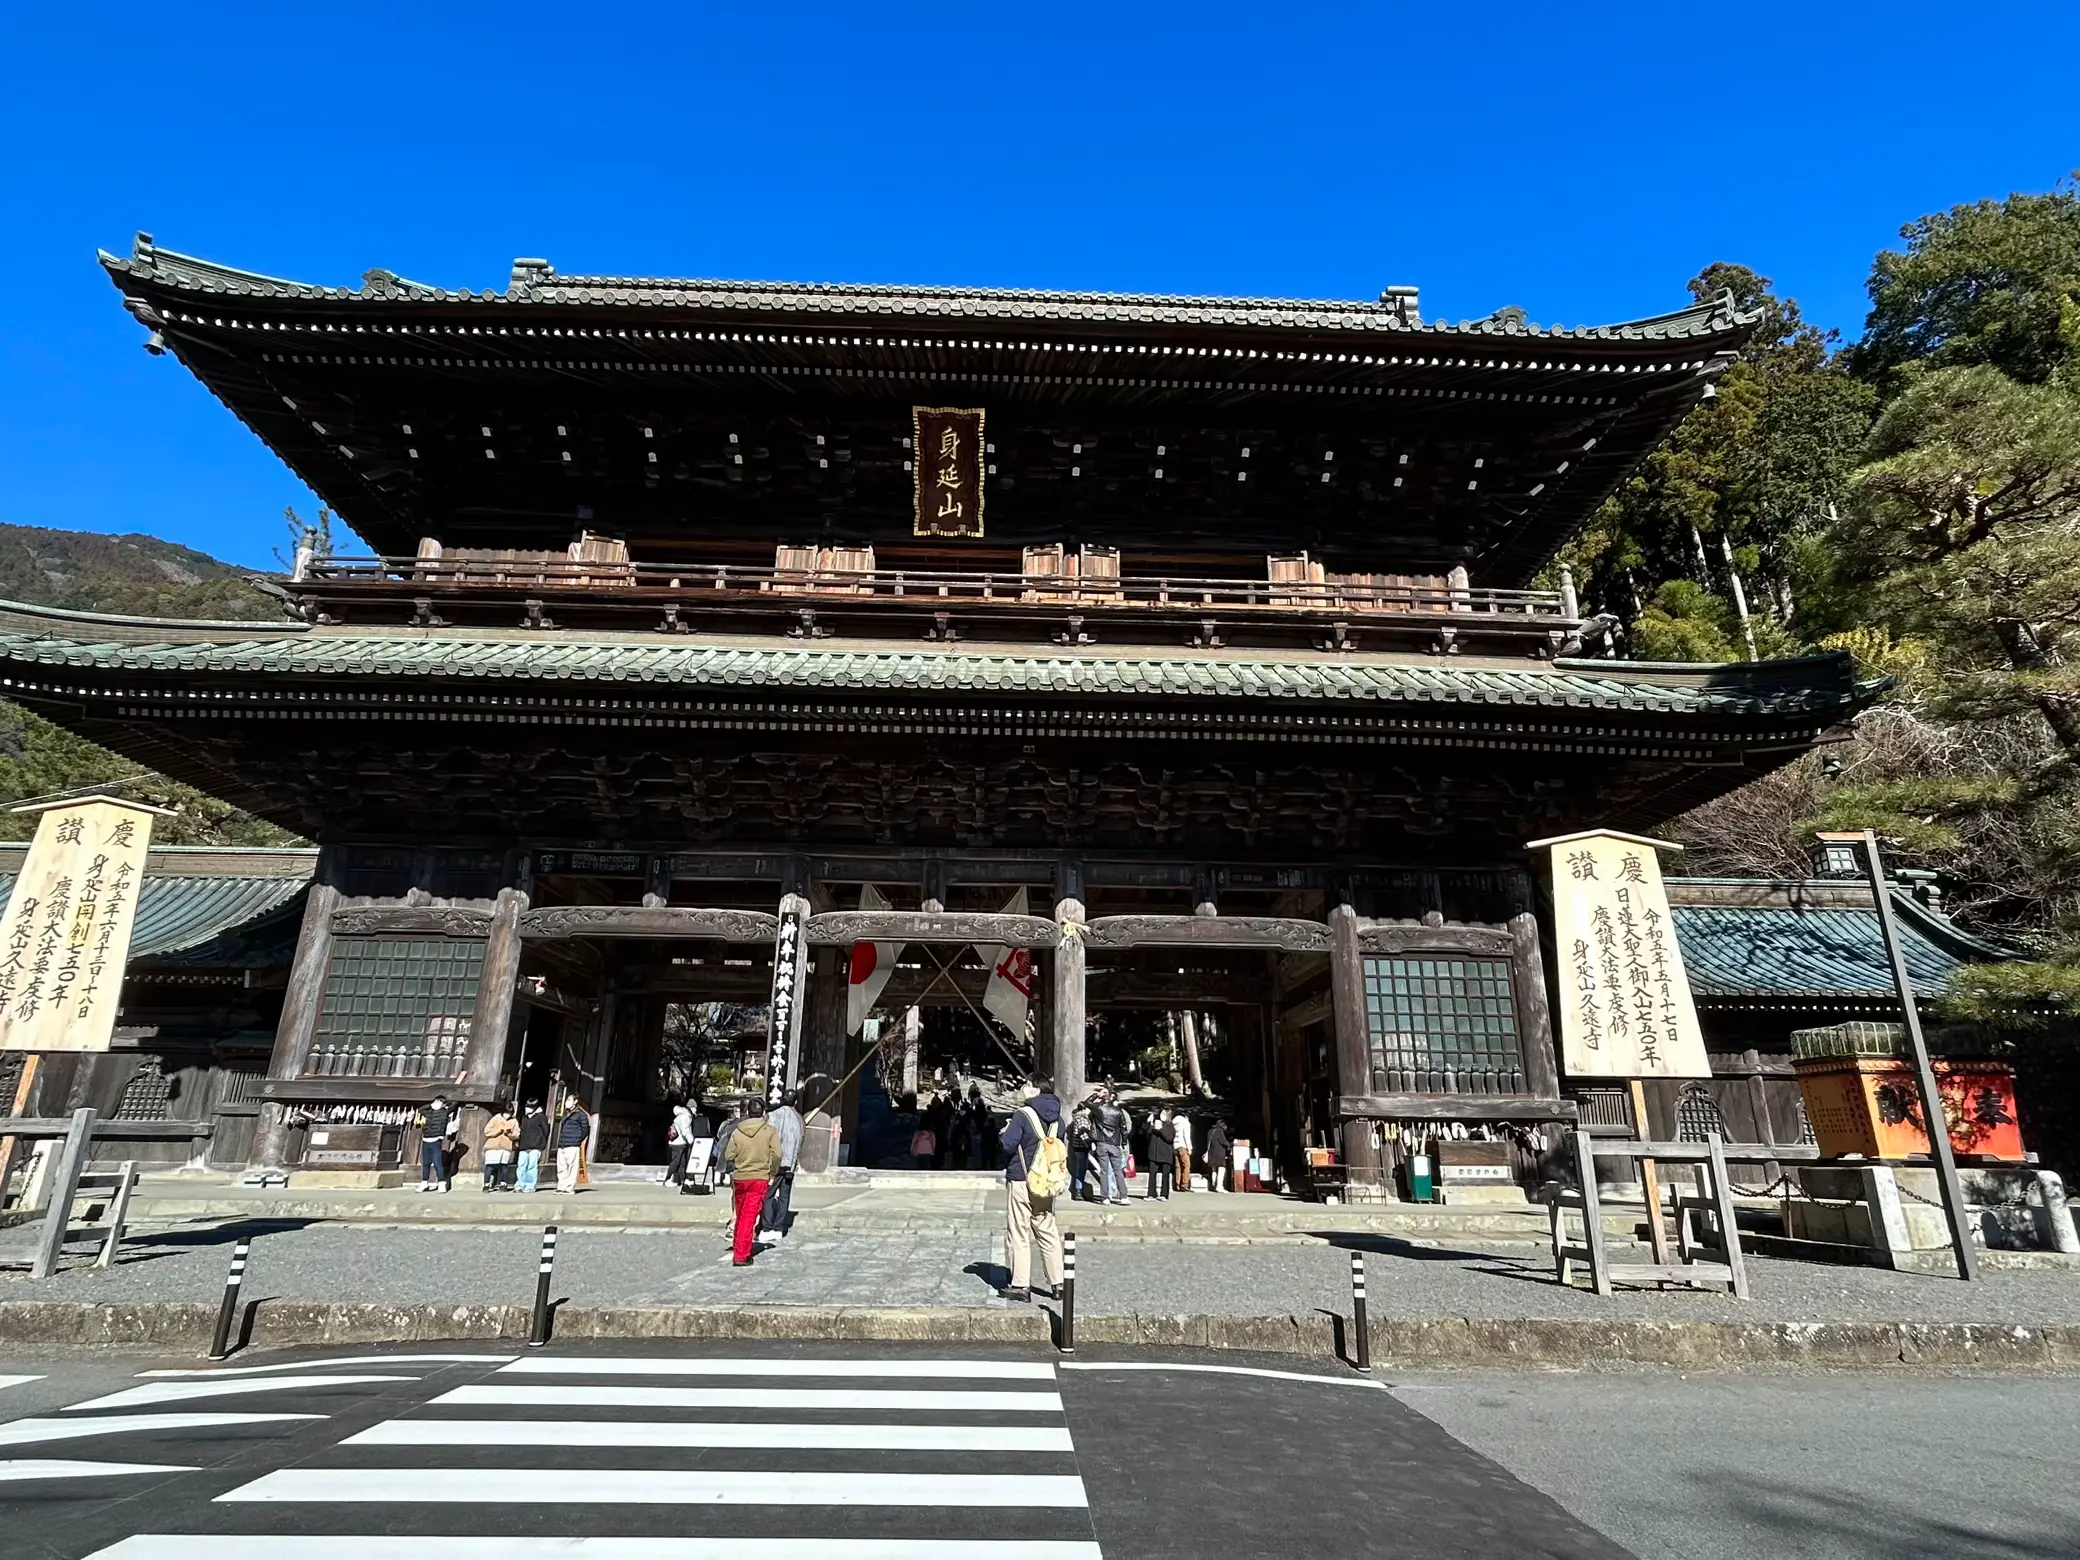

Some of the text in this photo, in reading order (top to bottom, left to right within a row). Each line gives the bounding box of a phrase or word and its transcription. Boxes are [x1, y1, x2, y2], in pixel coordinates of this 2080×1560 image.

[936, 425, 963, 518] 身延山
[1571, 938, 1603, 1050] 身延山久遠寺
[1641, 908, 1679, 1042] 令和五年五月十七日
[1972, 1087, 2013, 1130] 奉
